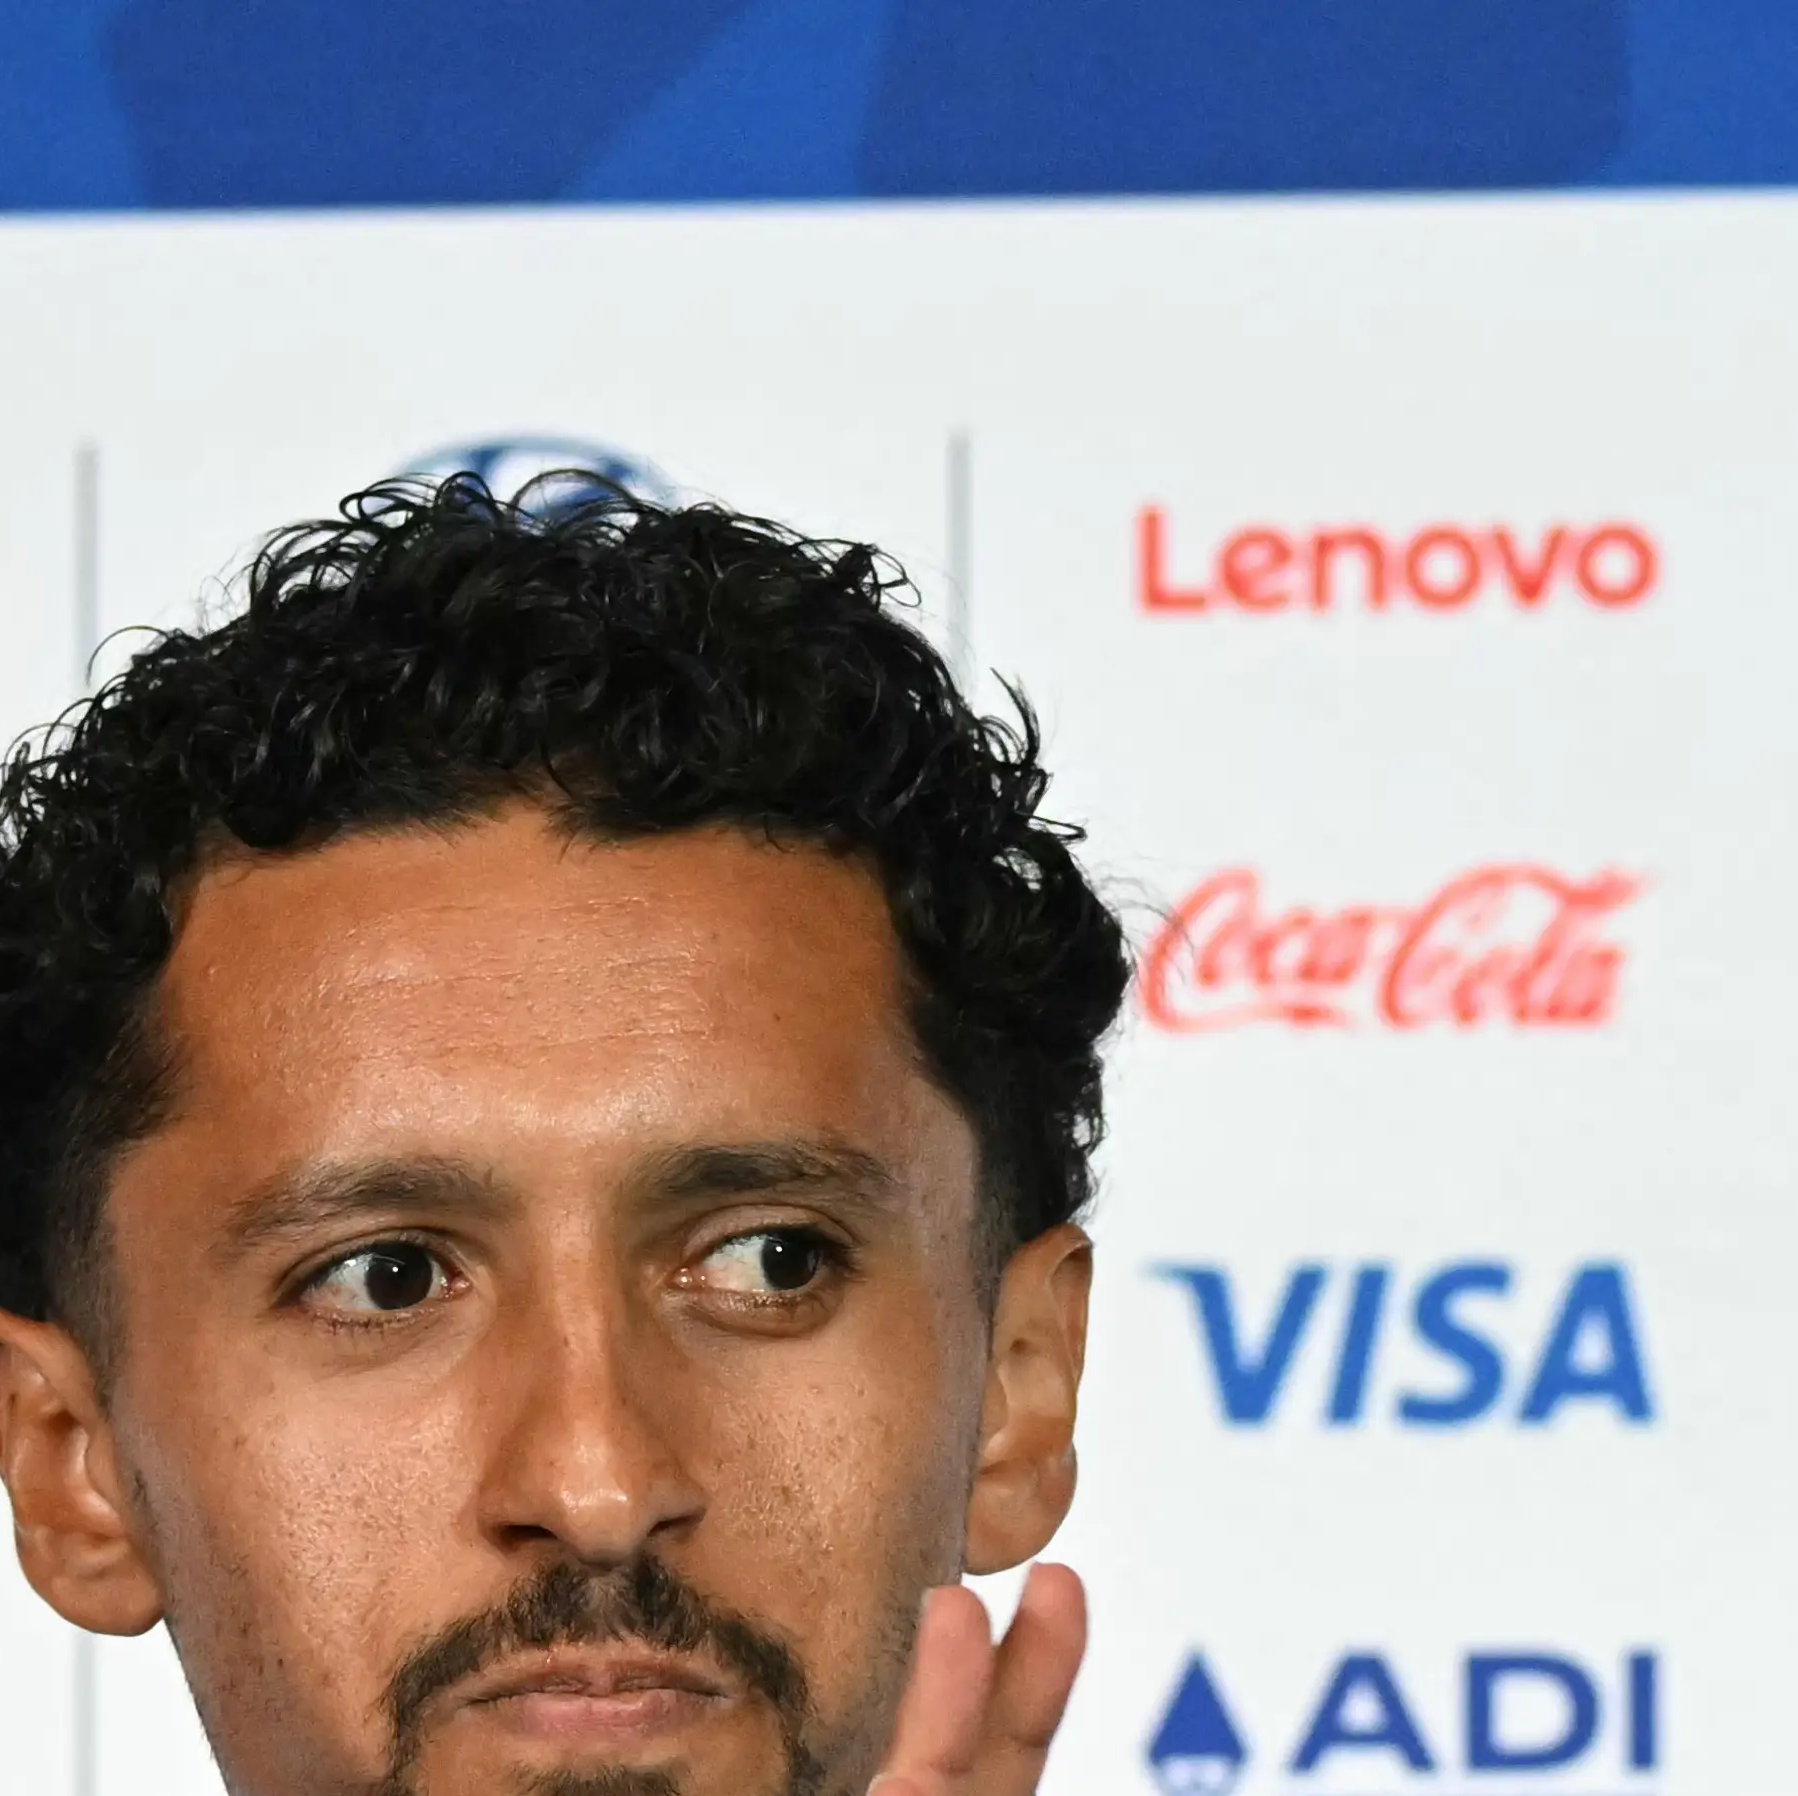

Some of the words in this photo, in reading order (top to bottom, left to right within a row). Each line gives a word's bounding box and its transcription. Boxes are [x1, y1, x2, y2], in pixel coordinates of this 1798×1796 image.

[1136, 506, 1660, 616] Lenovo
[1147, 1260, 1655, 1428] VISA
[1286, 1648, 1659, 1776] ADI
